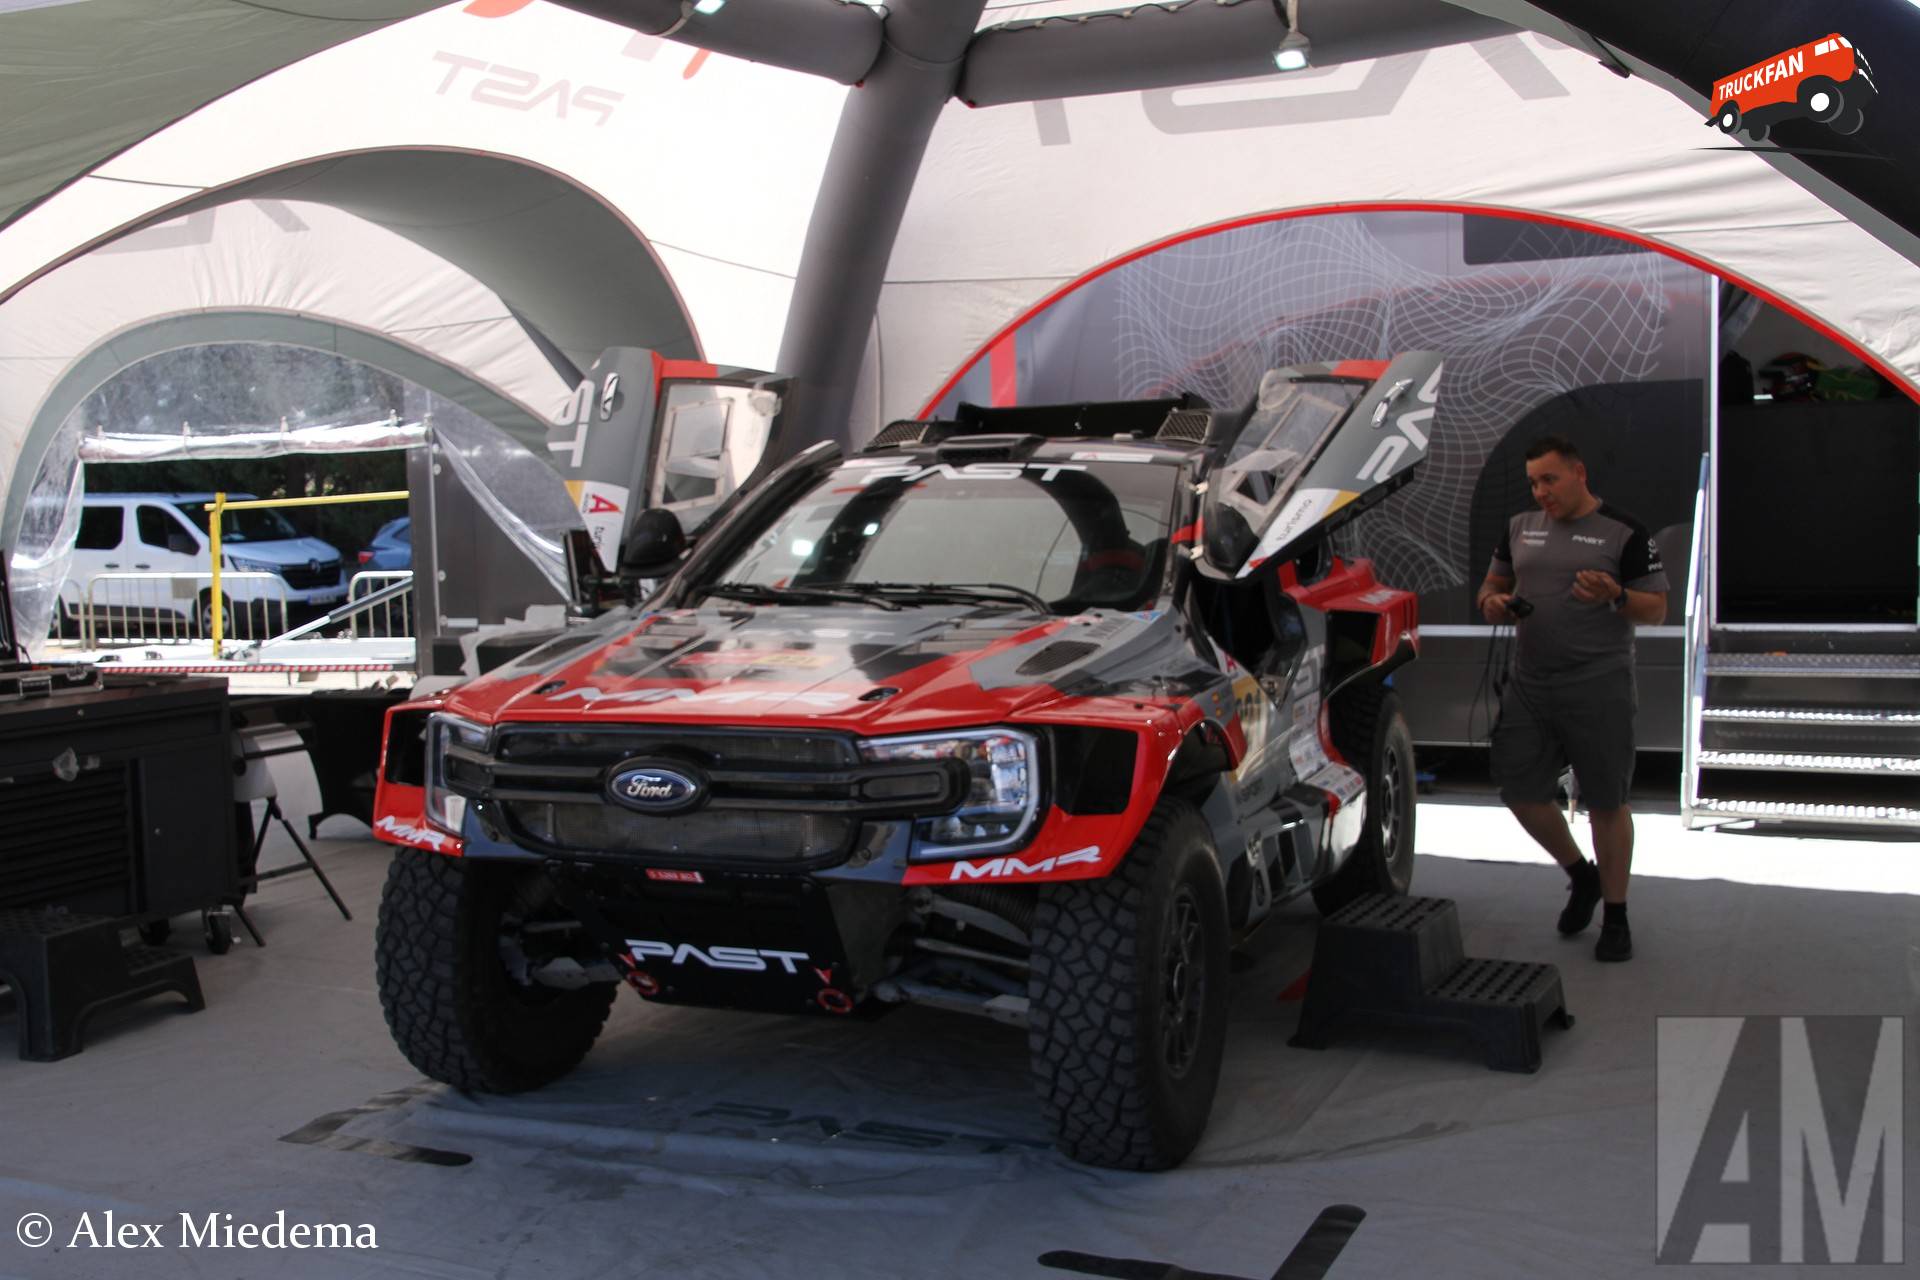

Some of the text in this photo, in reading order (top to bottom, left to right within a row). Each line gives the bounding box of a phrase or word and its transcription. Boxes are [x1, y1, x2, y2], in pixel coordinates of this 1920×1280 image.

[859, 463, 1088, 484] PAST
[546, 687, 850, 707] MMR
[626, 774, 673, 799] Ford
[376, 815, 446, 851] MMR
[950, 845, 1102, 881] MMR
[624, 939, 810, 974] PAST
